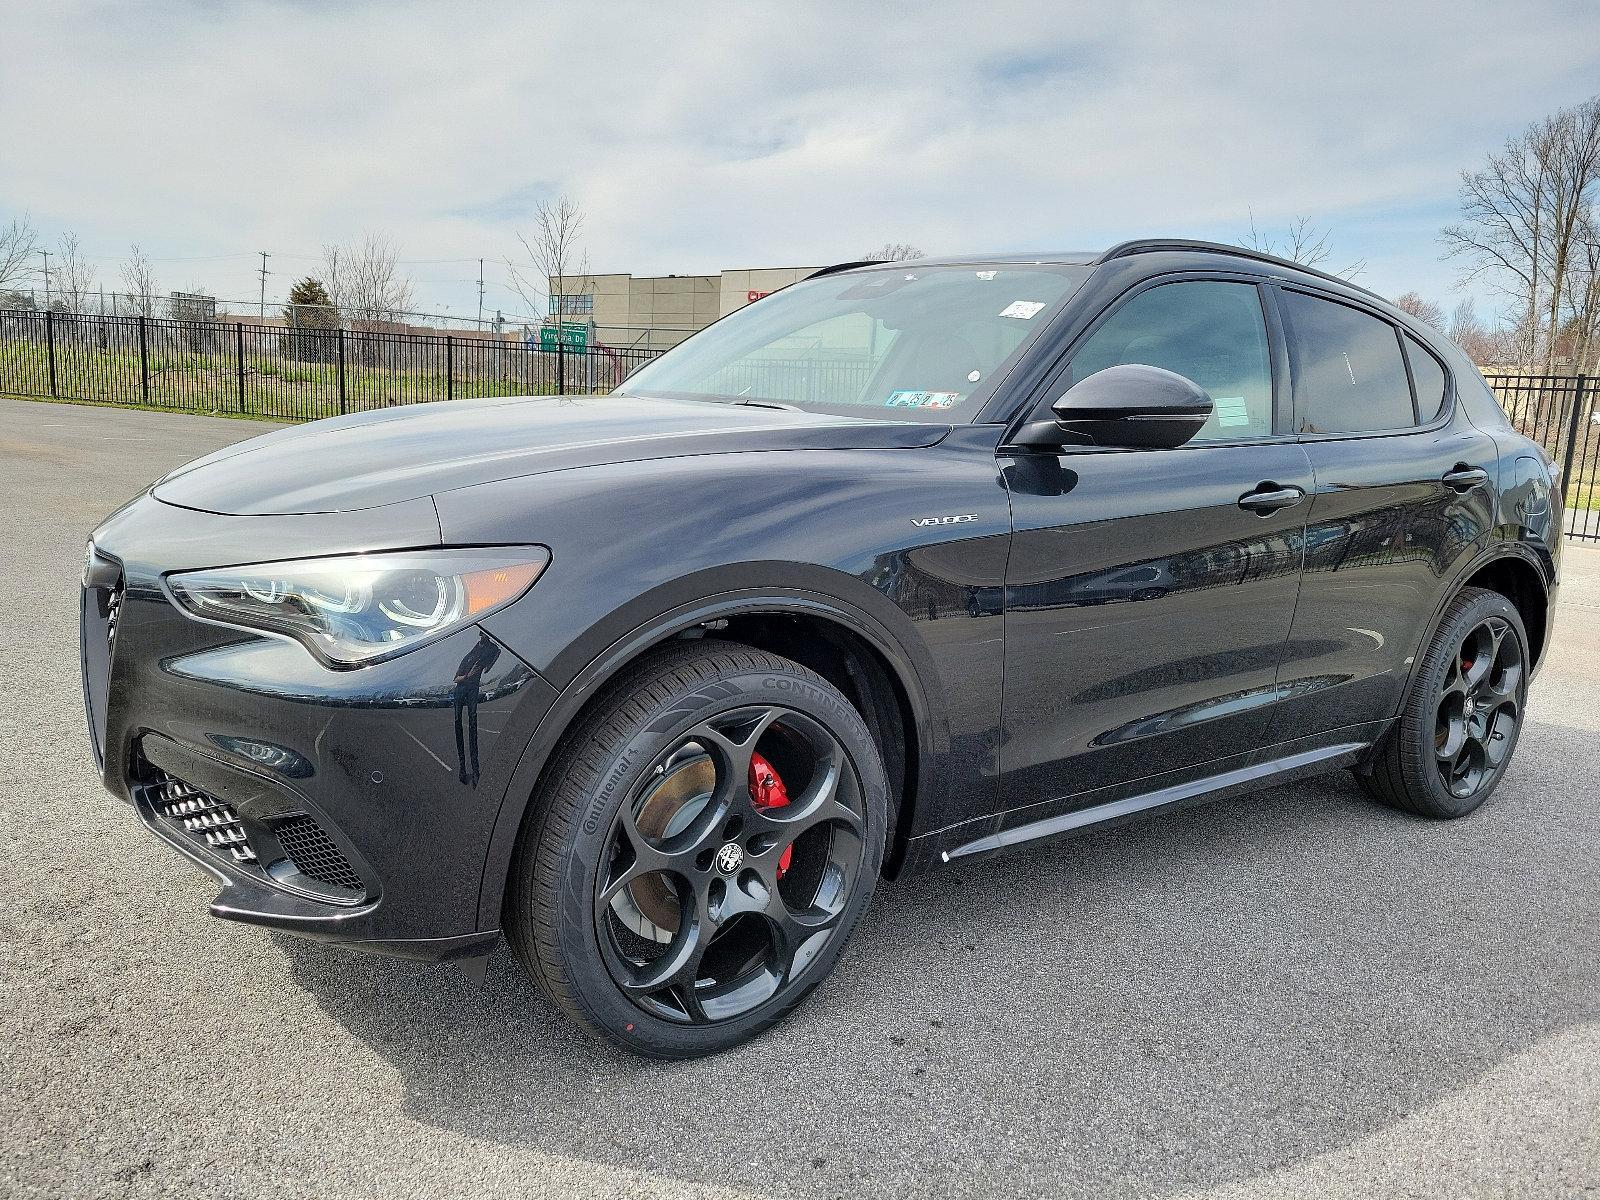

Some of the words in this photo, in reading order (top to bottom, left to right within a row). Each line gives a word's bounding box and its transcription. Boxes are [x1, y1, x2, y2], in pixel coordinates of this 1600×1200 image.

[543, 331, 572, 343] Virgnia
[575, 335, 585, 343] Dr
[910, 513, 979, 527] VELOCE
[583, 755, 632, 836] Continental
